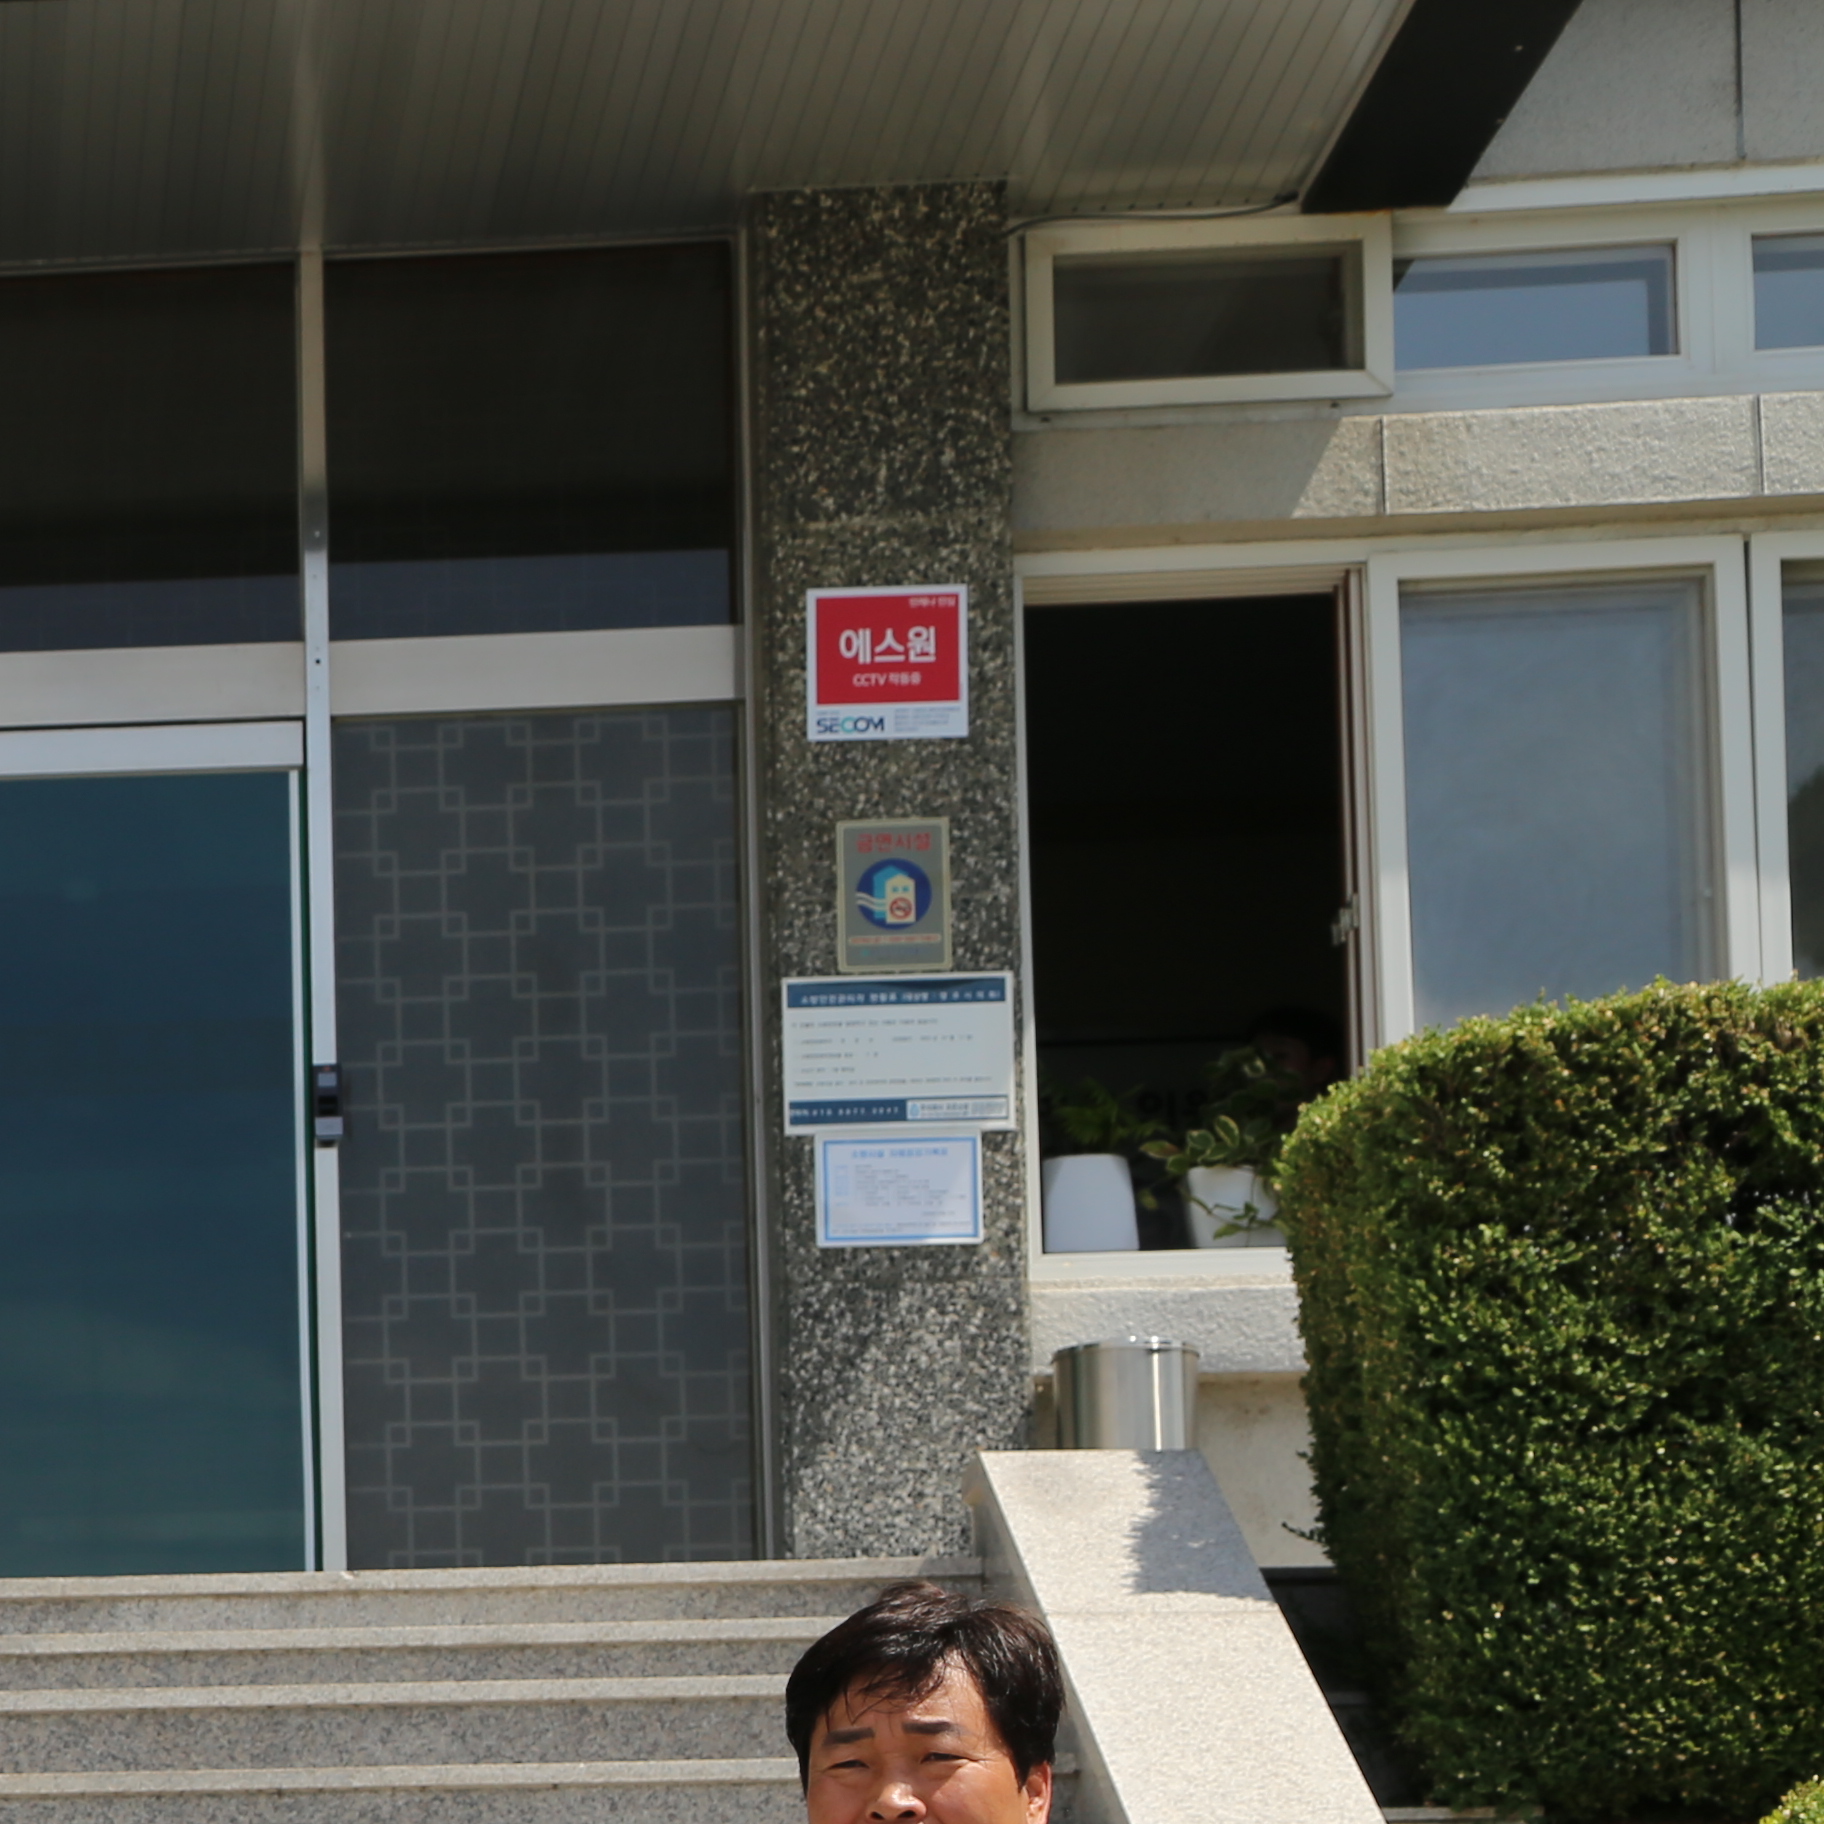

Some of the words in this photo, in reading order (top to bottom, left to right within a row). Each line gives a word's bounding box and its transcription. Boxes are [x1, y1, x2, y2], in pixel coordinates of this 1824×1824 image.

[838, 625, 937, 665] 에스원
[853, 673, 887, 687] CCTV
[816, 715, 885, 734] SECOM
[855, 832, 933, 854] 금연시설
